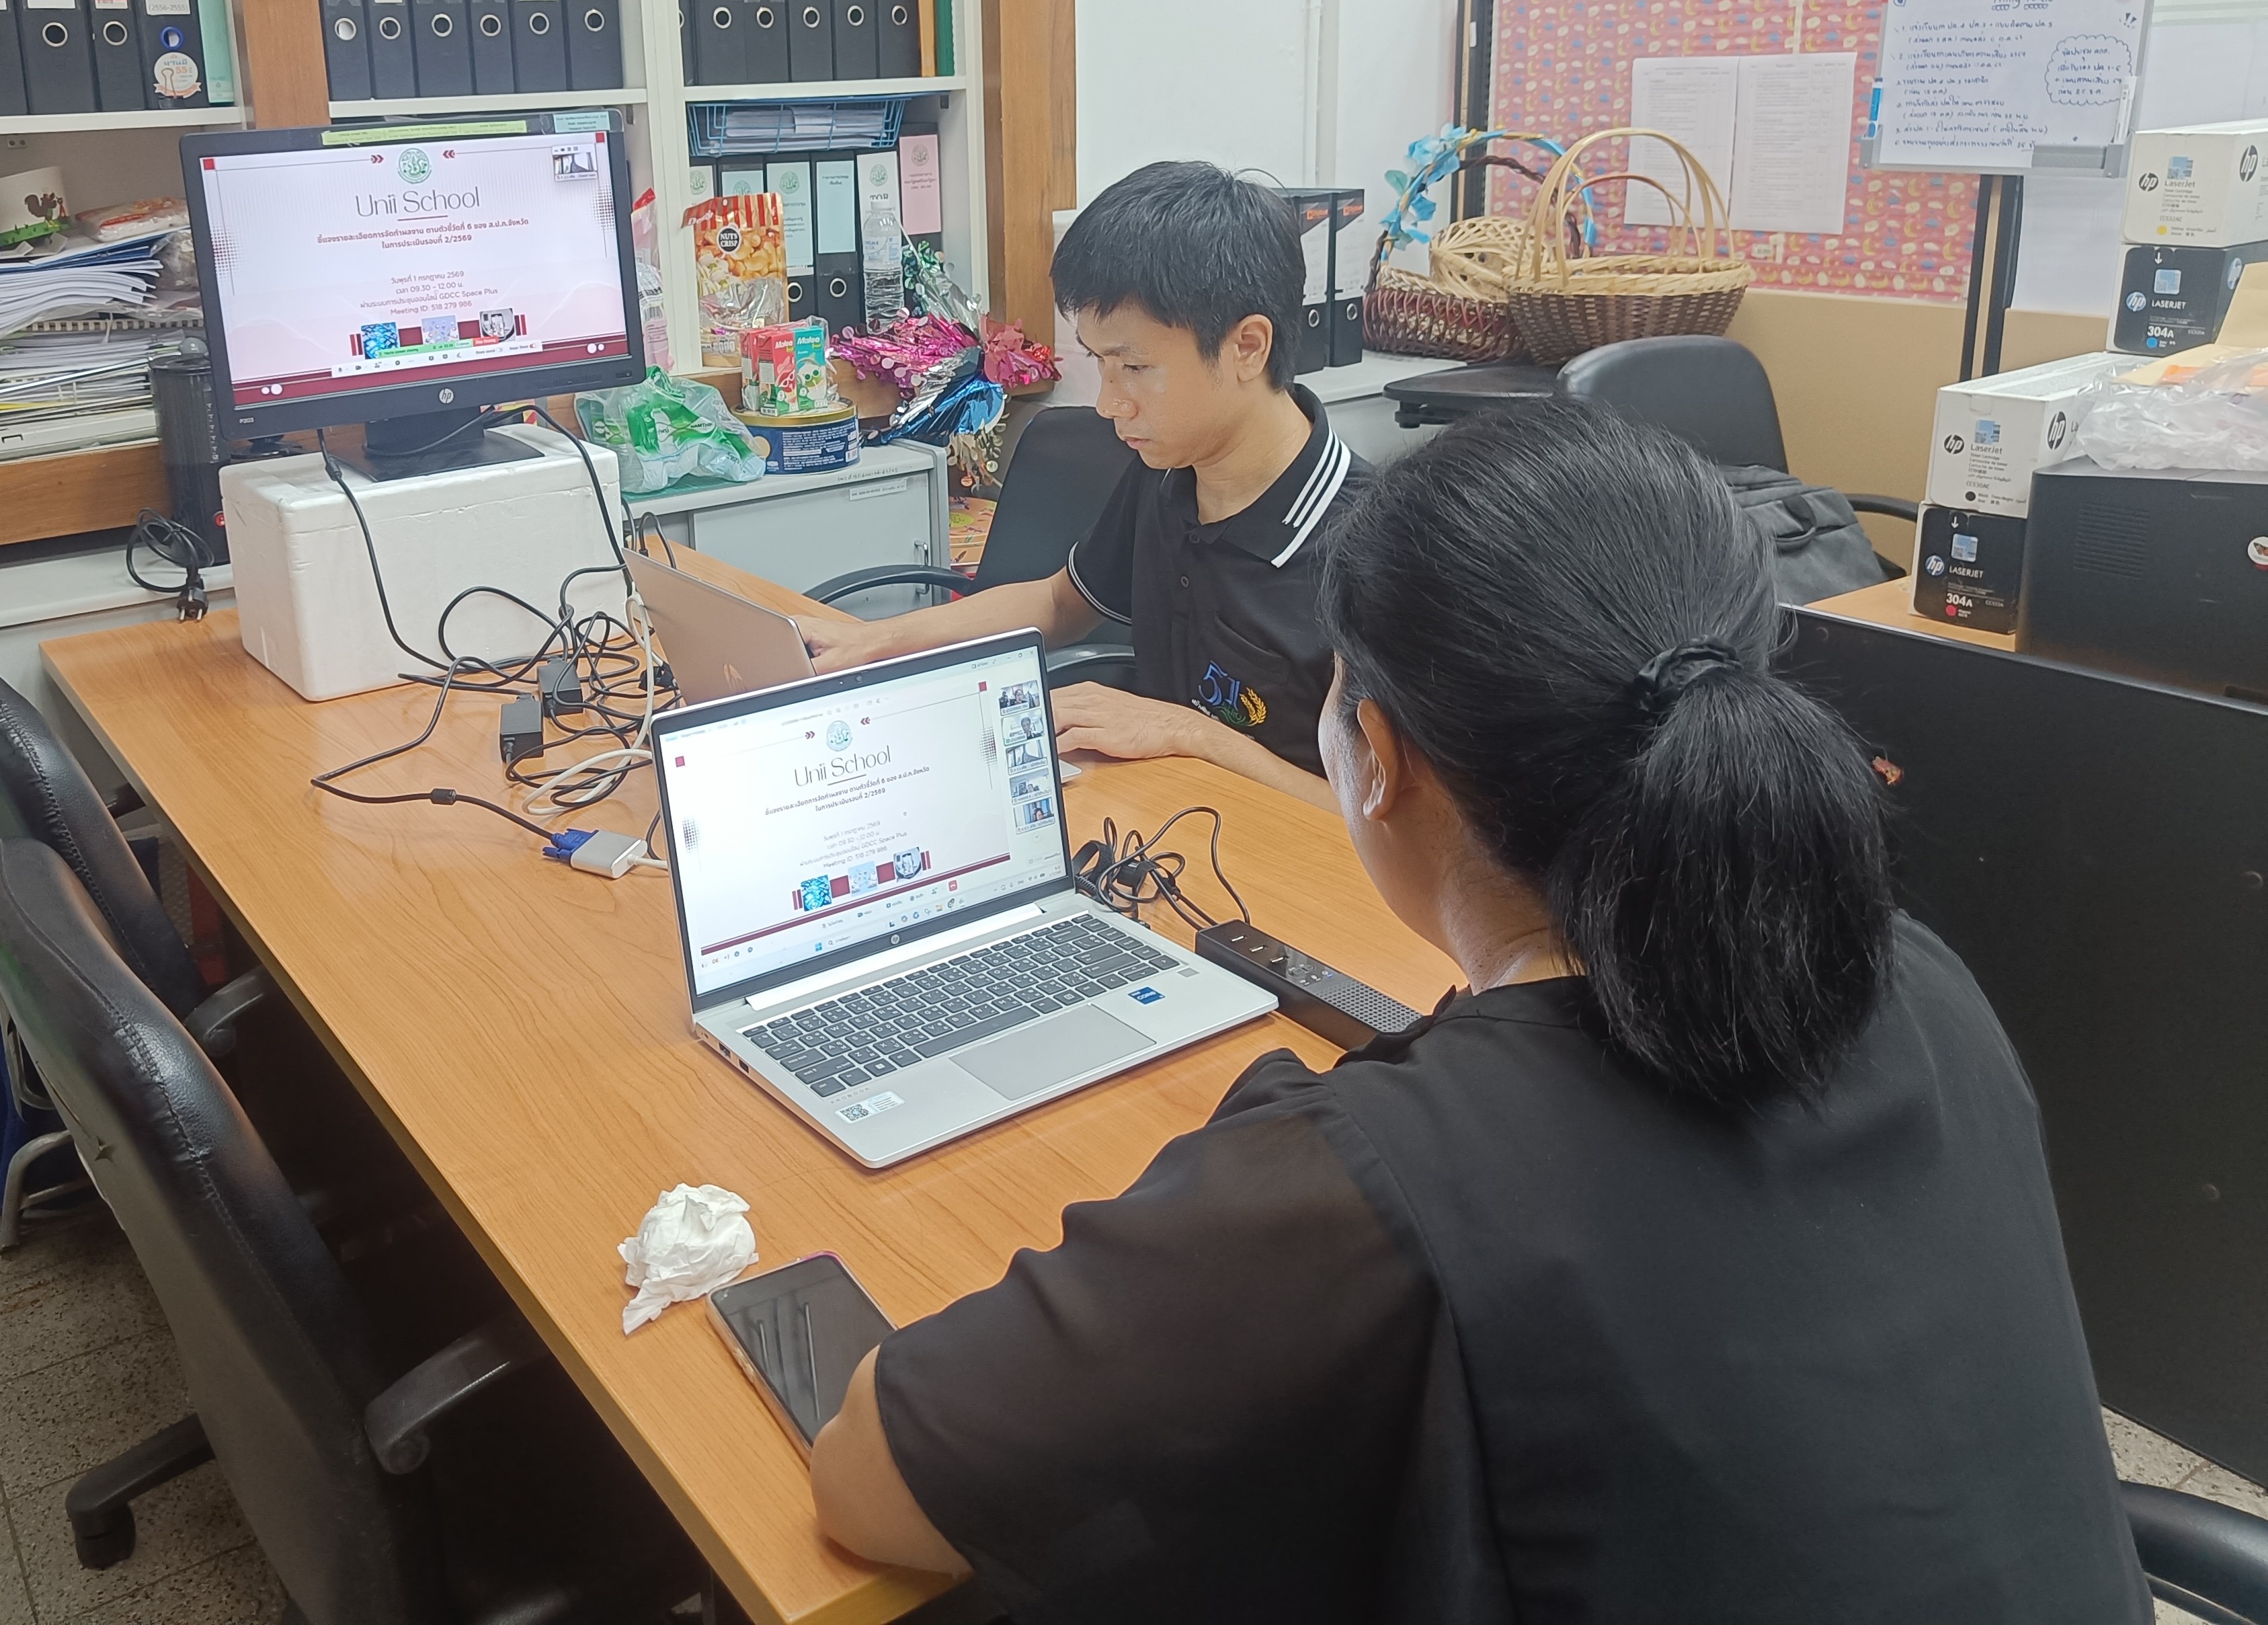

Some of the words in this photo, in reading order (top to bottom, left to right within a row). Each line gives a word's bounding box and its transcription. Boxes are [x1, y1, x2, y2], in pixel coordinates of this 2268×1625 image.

[2240, 145, 2259, 183] hp
[2139, 172, 2159, 192] hp
[2164, 179, 2196, 188] LaserJet
[403, 186, 480, 213] School
[444, 234, 473, 243] 2/2569
[720, 233, 738, 241] NUTS
[720, 239, 738, 248] CRISP
[446, 270, 464, 278] 2569
[439, 291, 460, 300] GDCC
[462, 290, 483, 299] Space
[2126, 292, 2147, 311] hp
[391, 307, 419, 315] Meeting
[431, 303, 443, 311] 518
[444, 301, 457, 309] 279
[2151, 299, 2187, 310] LASERJET
[2148, 325, 2174, 338] 304A
[439, 388, 454, 403] hp
[2048, 411, 2066, 450] hp
[1944, 434, 1965, 454] hp
[1970, 444, 2002, 454] LaserJet
[1925, 555, 1945, 576] hp
[1949, 565, 1984, 579] LASERJET
[1946, 592, 1973, 608] 304A
[831, 745, 891, 777] School
[864, 787, 886, 799] 2/2569
[823, 859, 846, 869] Meeting
